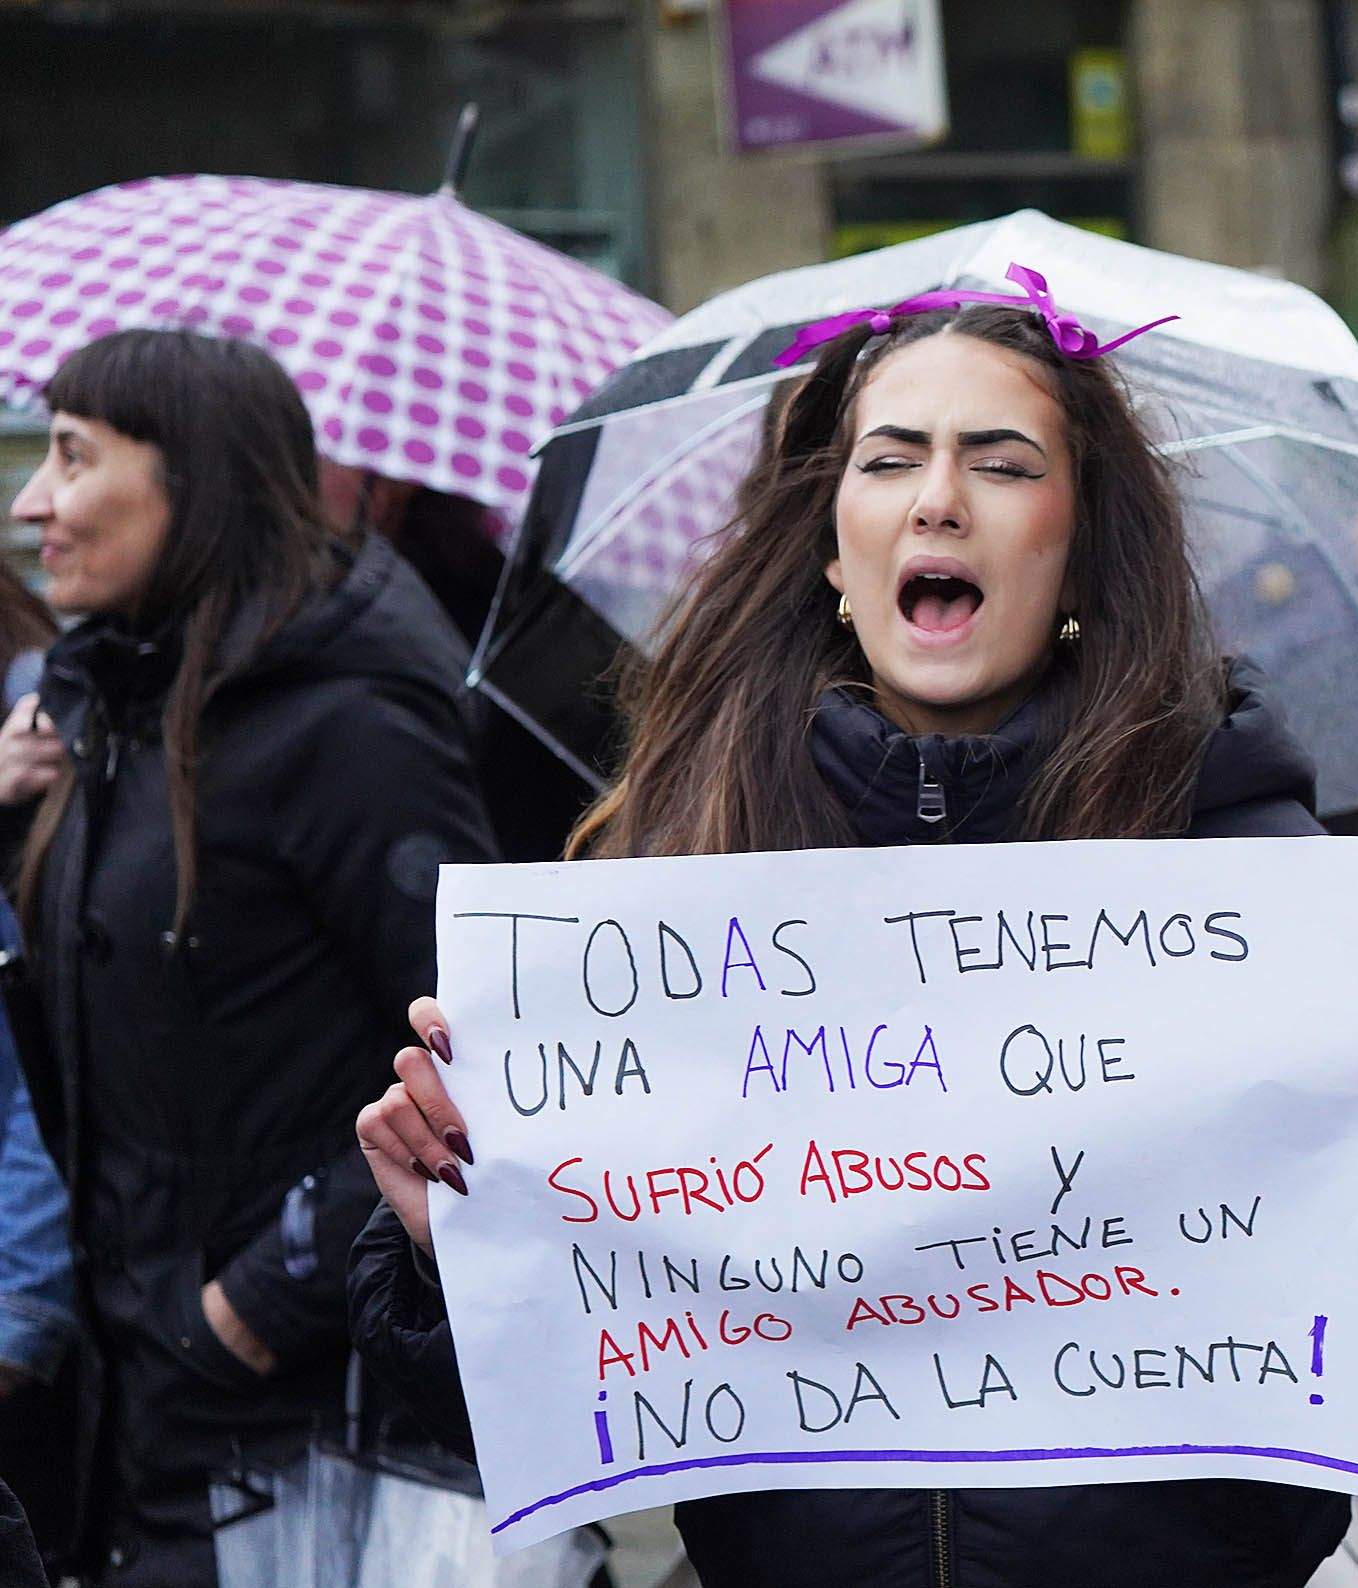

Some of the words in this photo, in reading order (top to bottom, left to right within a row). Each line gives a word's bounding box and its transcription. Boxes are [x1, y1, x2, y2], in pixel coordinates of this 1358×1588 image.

[454, 913, 816, 1019] TODAS
[884, 909, 1248, 983] TENEMOS
[504, 1038, 651, 1116] UNA
[742, 1024, 947, 1098] AMIGA
[1000, 1024, 1135, 1096] QUE
[801, 1140, 990, 1203] ABUSOS
[572, 1243, 864, 1313] NINGUNO
[1179, 1196, 1261, 1243] UN
[845, 1266, 1180, 1328] ABUSADOR.
[594, 1379, 746, 1464] ¡NO
[786, 1362, 900, 1433] DA
[933, 1353, 1018, 1409] LA
[1054, 1315, 1328, 1405] CUENTA!
